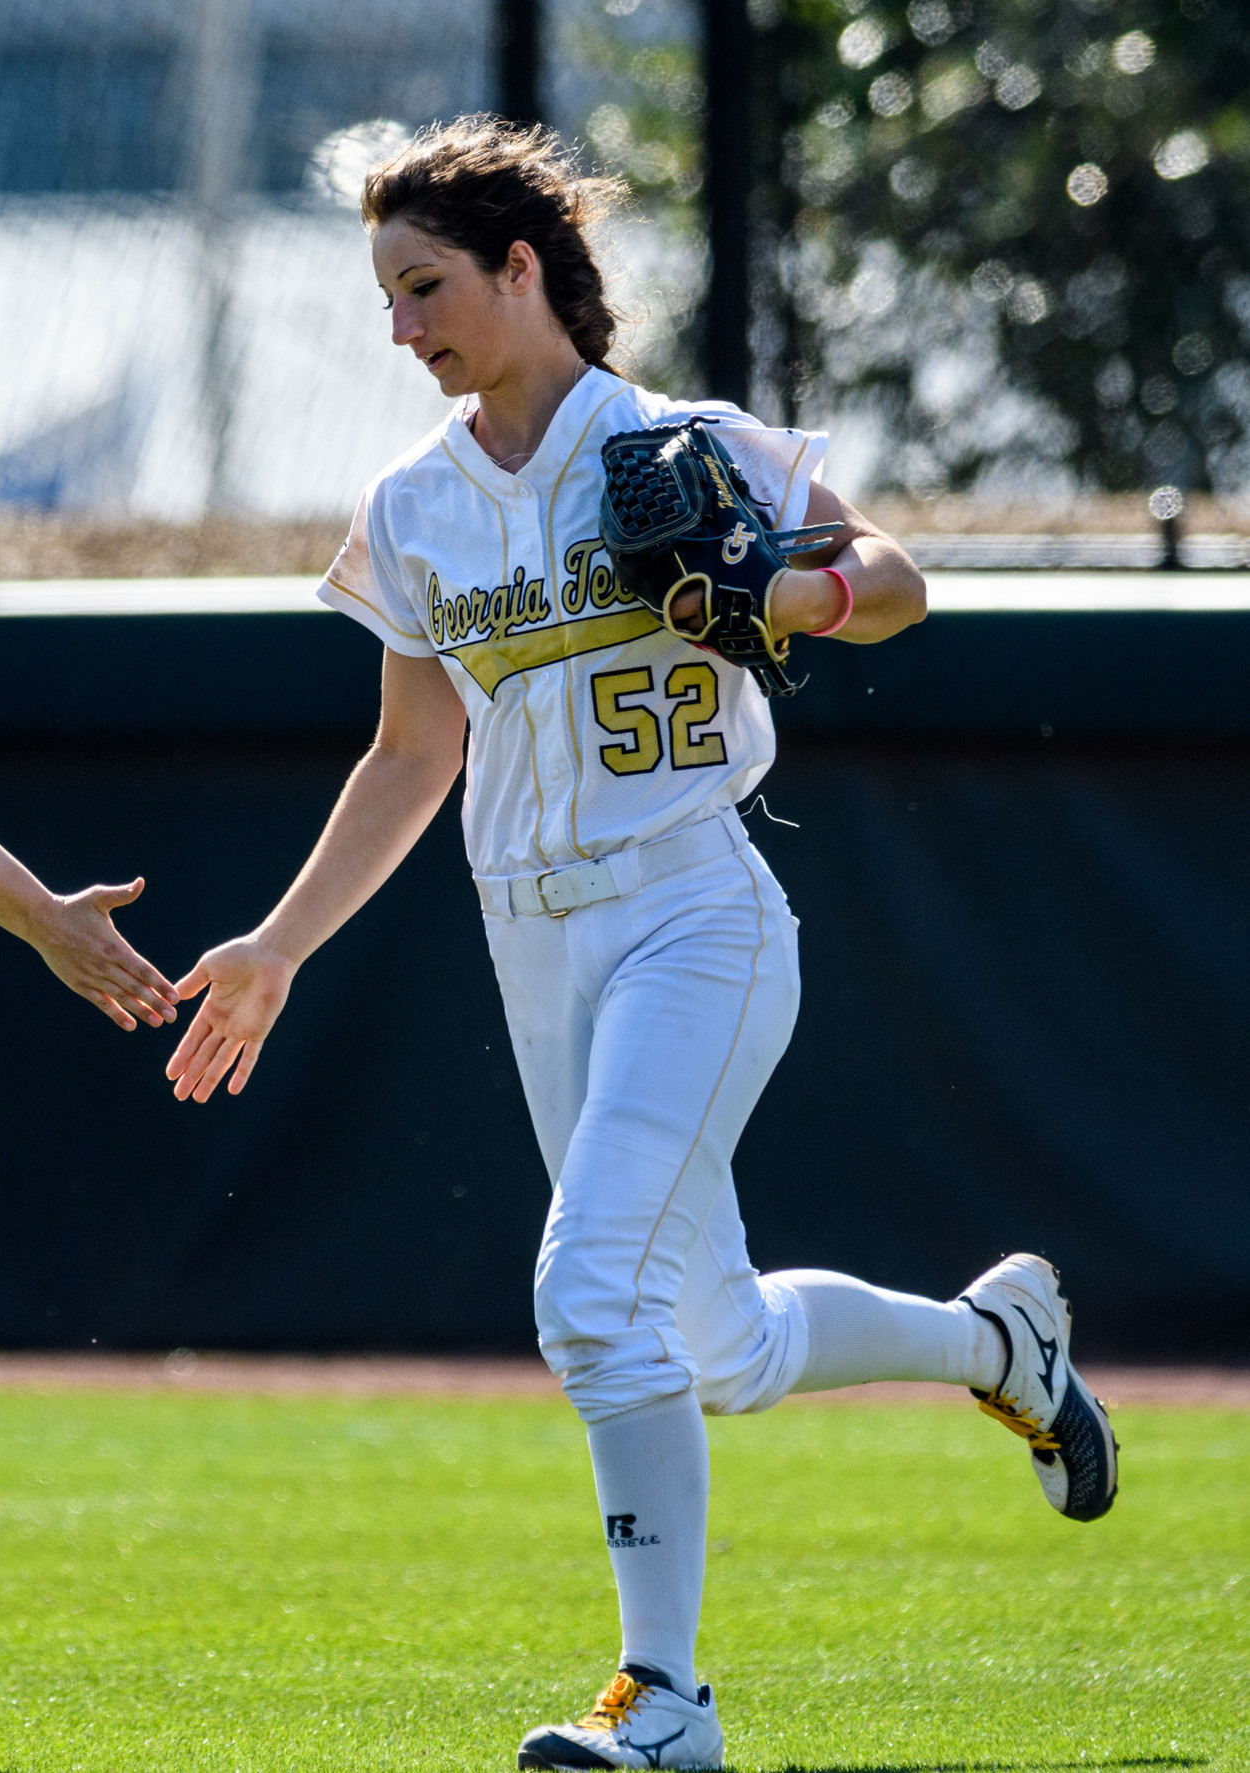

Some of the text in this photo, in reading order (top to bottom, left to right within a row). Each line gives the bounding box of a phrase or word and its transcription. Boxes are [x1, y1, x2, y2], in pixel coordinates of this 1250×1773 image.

[427, 537, 638, 645] Georgia Tec
[590, 661, 729, 777] 52
